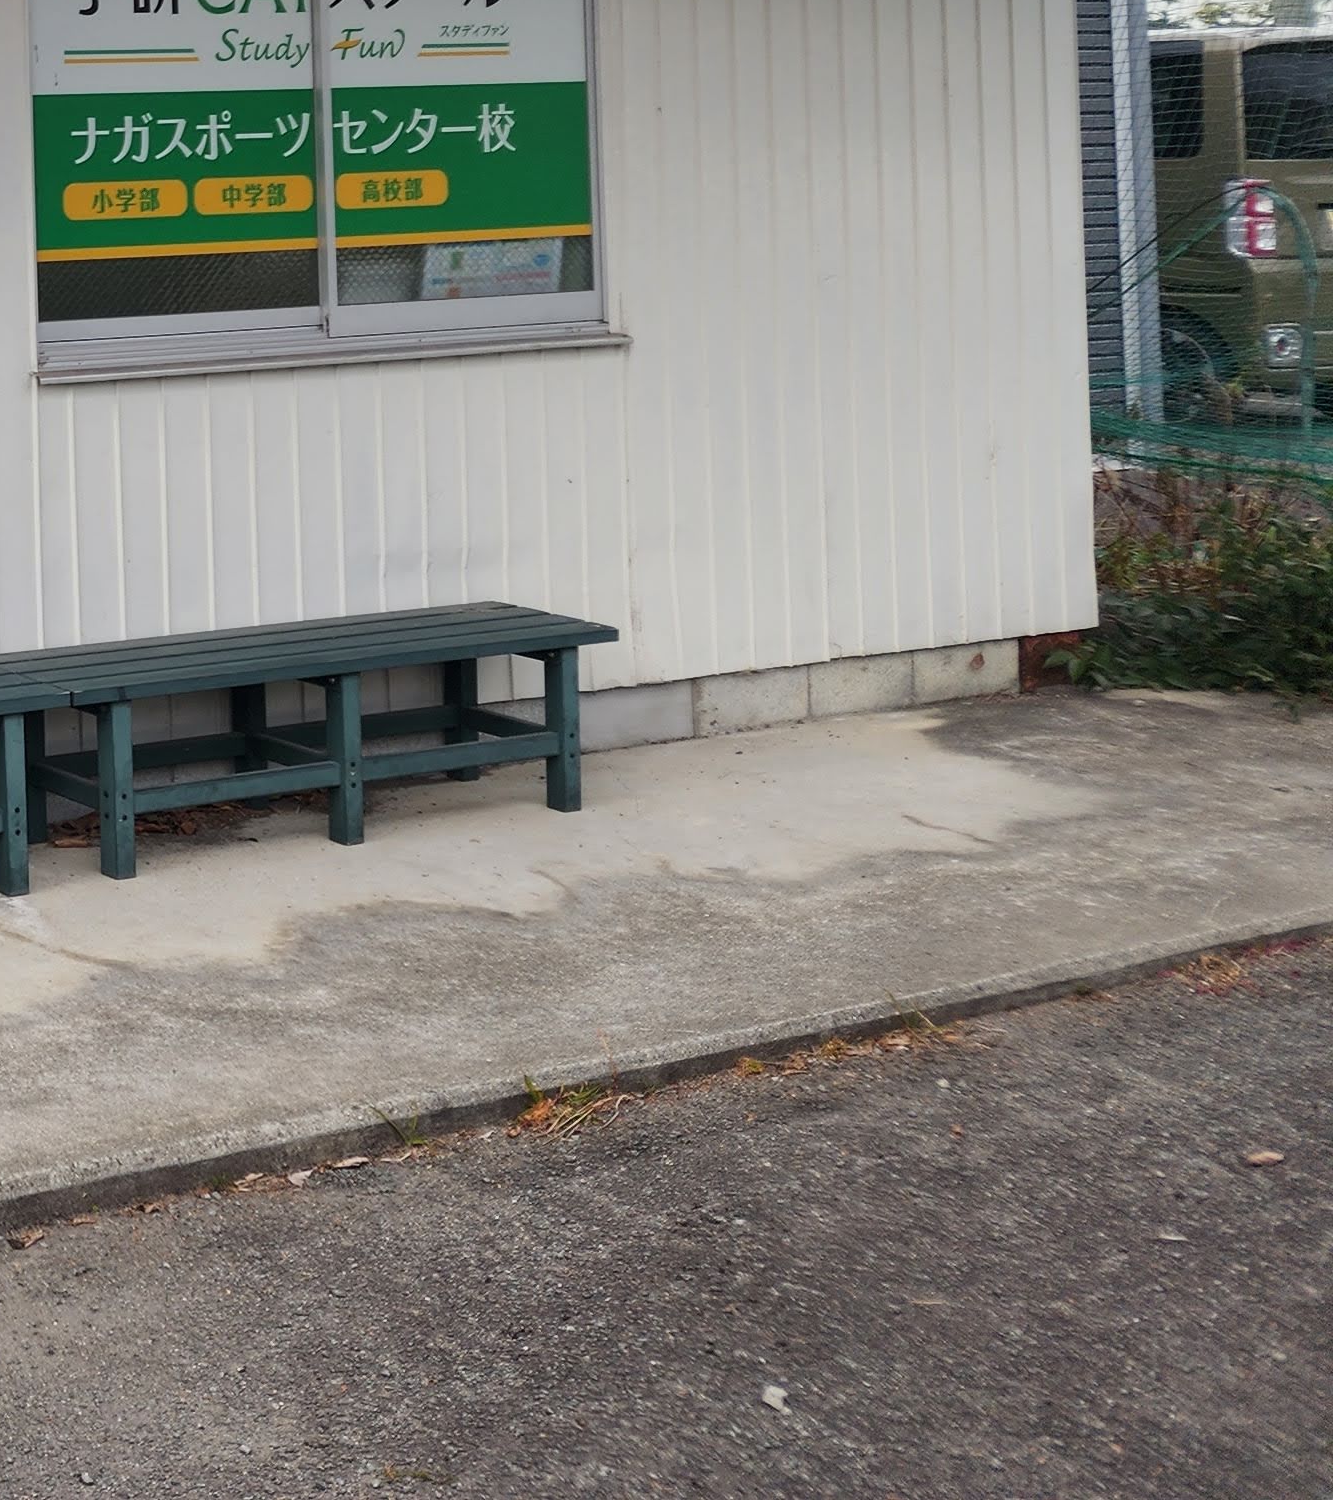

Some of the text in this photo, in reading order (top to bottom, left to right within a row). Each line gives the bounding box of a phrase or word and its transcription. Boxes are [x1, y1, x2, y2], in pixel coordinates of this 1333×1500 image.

[215, 28, 310, 68] Study
[439, 24, 510, 38] スタディファン
[91, 178, 424, 213] 小学部 中学部 高校部
